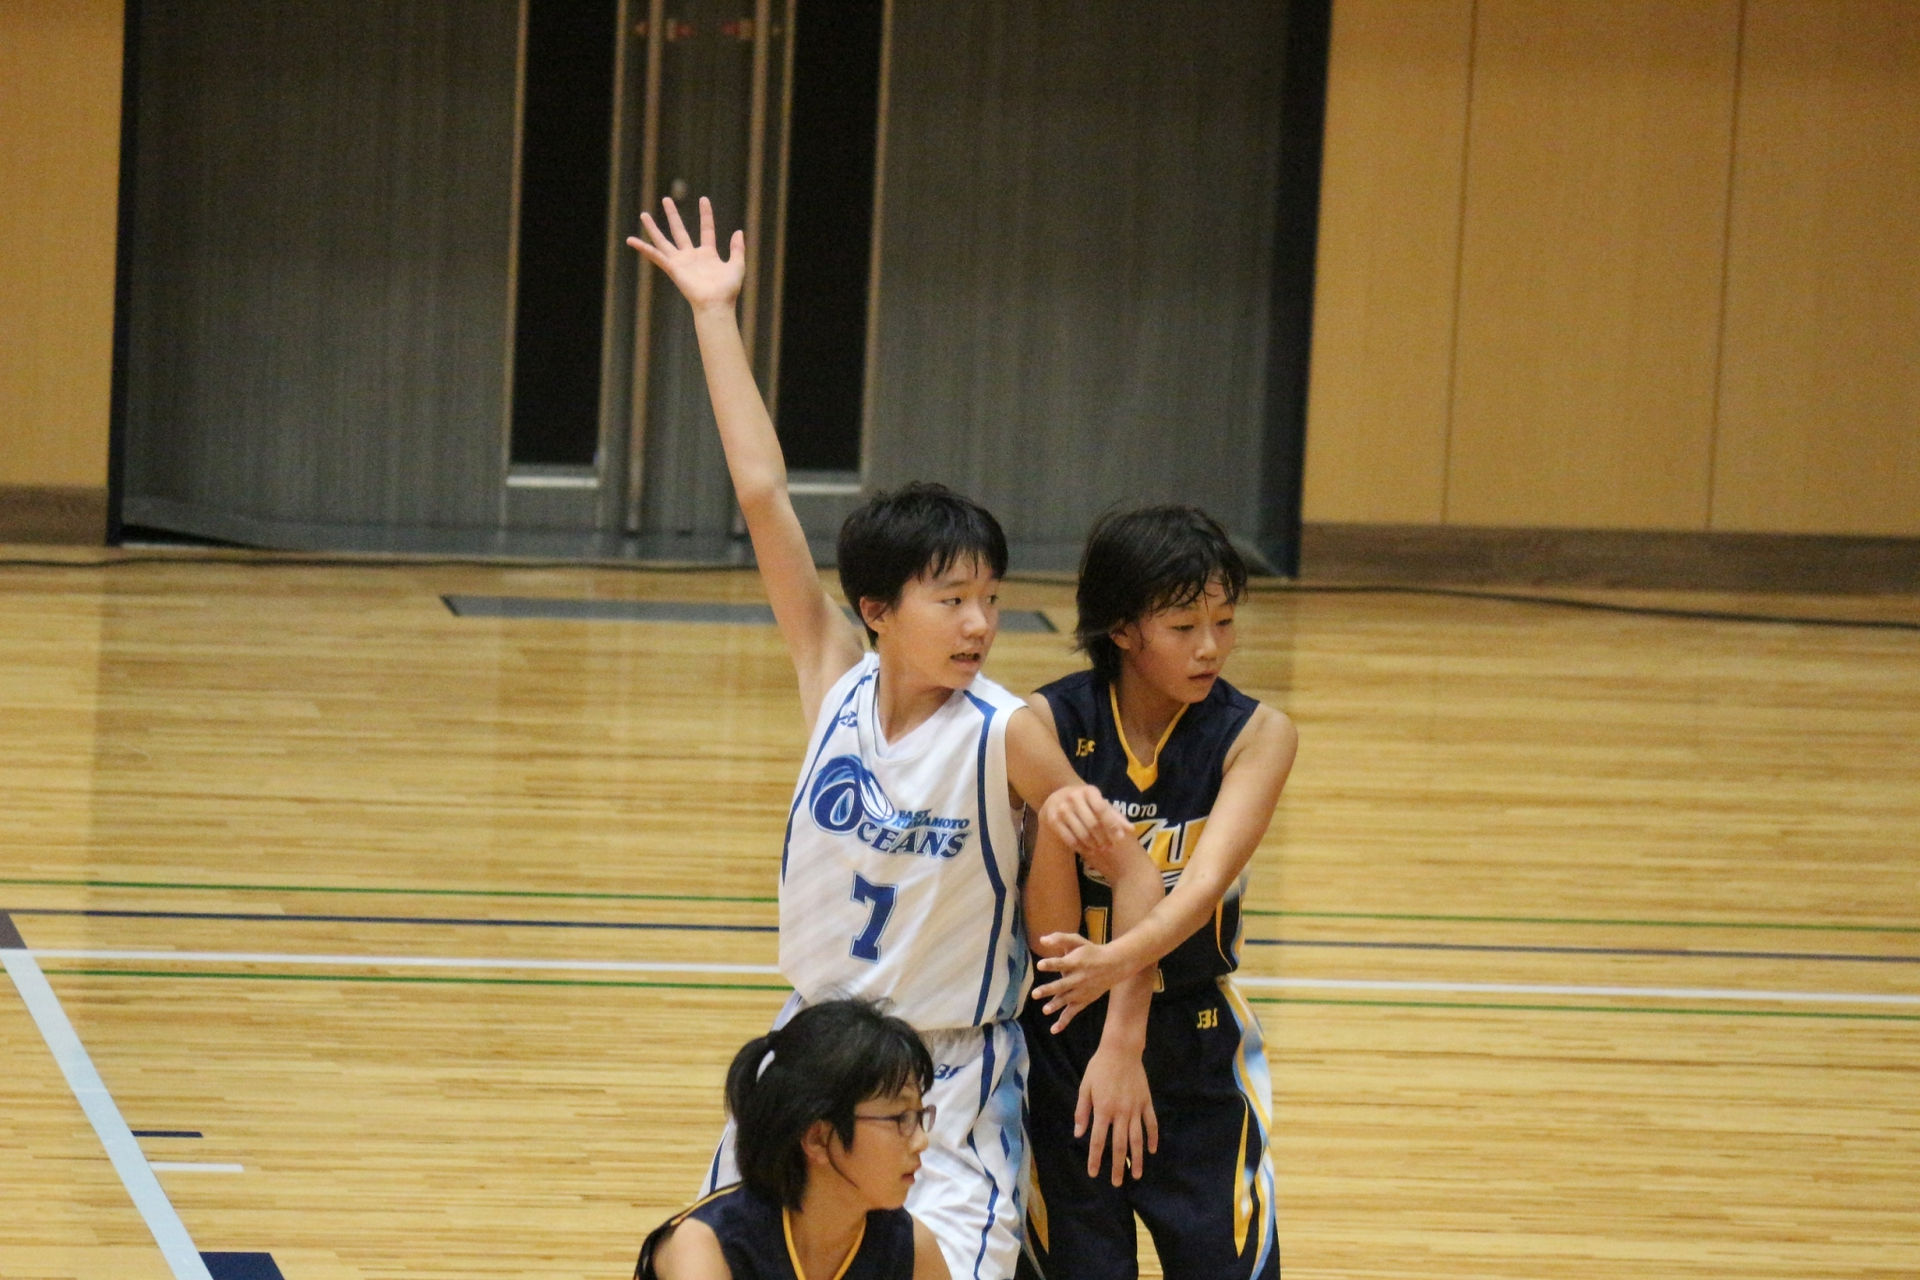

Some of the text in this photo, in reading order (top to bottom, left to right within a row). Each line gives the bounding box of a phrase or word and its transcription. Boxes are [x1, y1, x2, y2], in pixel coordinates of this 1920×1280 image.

[811, 780, 970, 858] OCEANS
[1105, 799, 1158, 817] MOTO
[850, 871, 898, 963] 7
